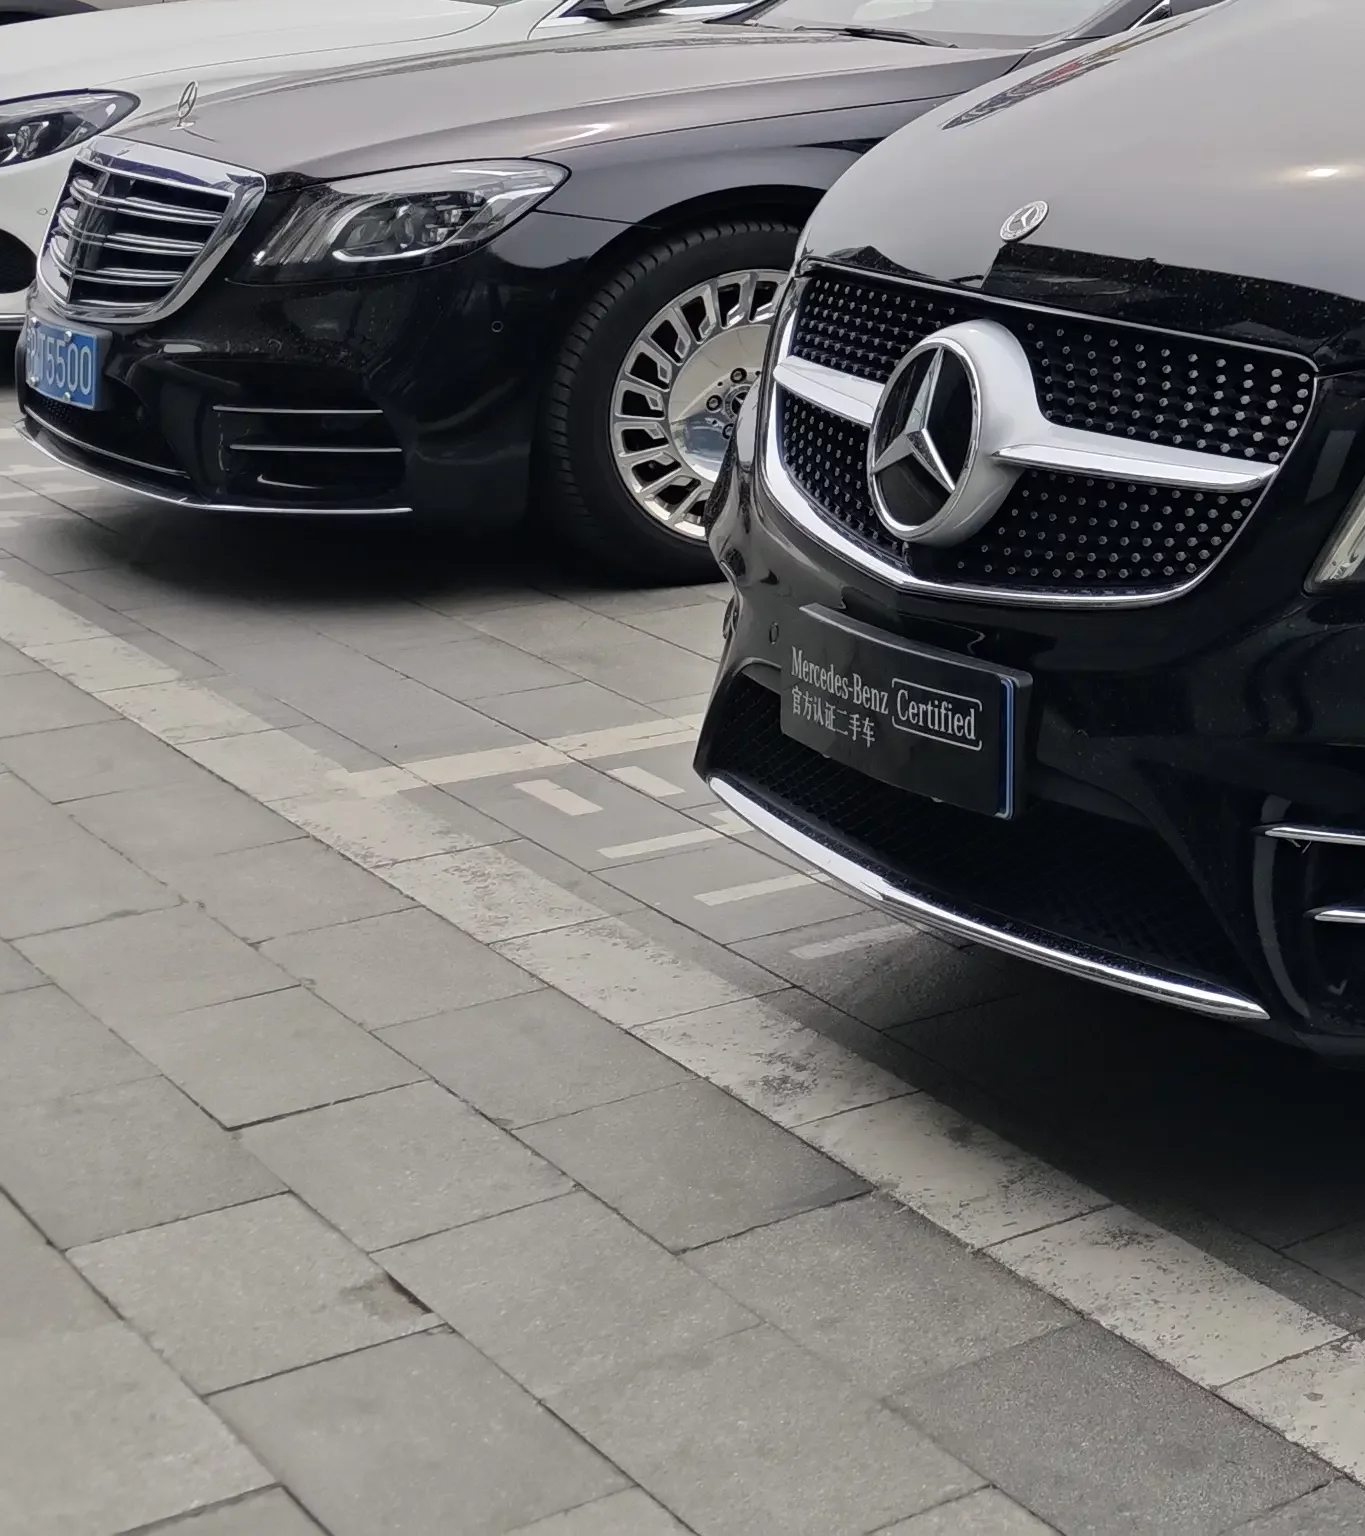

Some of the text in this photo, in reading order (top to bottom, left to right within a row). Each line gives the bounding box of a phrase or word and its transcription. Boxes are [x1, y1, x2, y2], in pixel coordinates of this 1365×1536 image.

[790, 645, 976, 741] Mercedes-Benz Certified
[790, 685, 876, 748] 官方认证二手车
